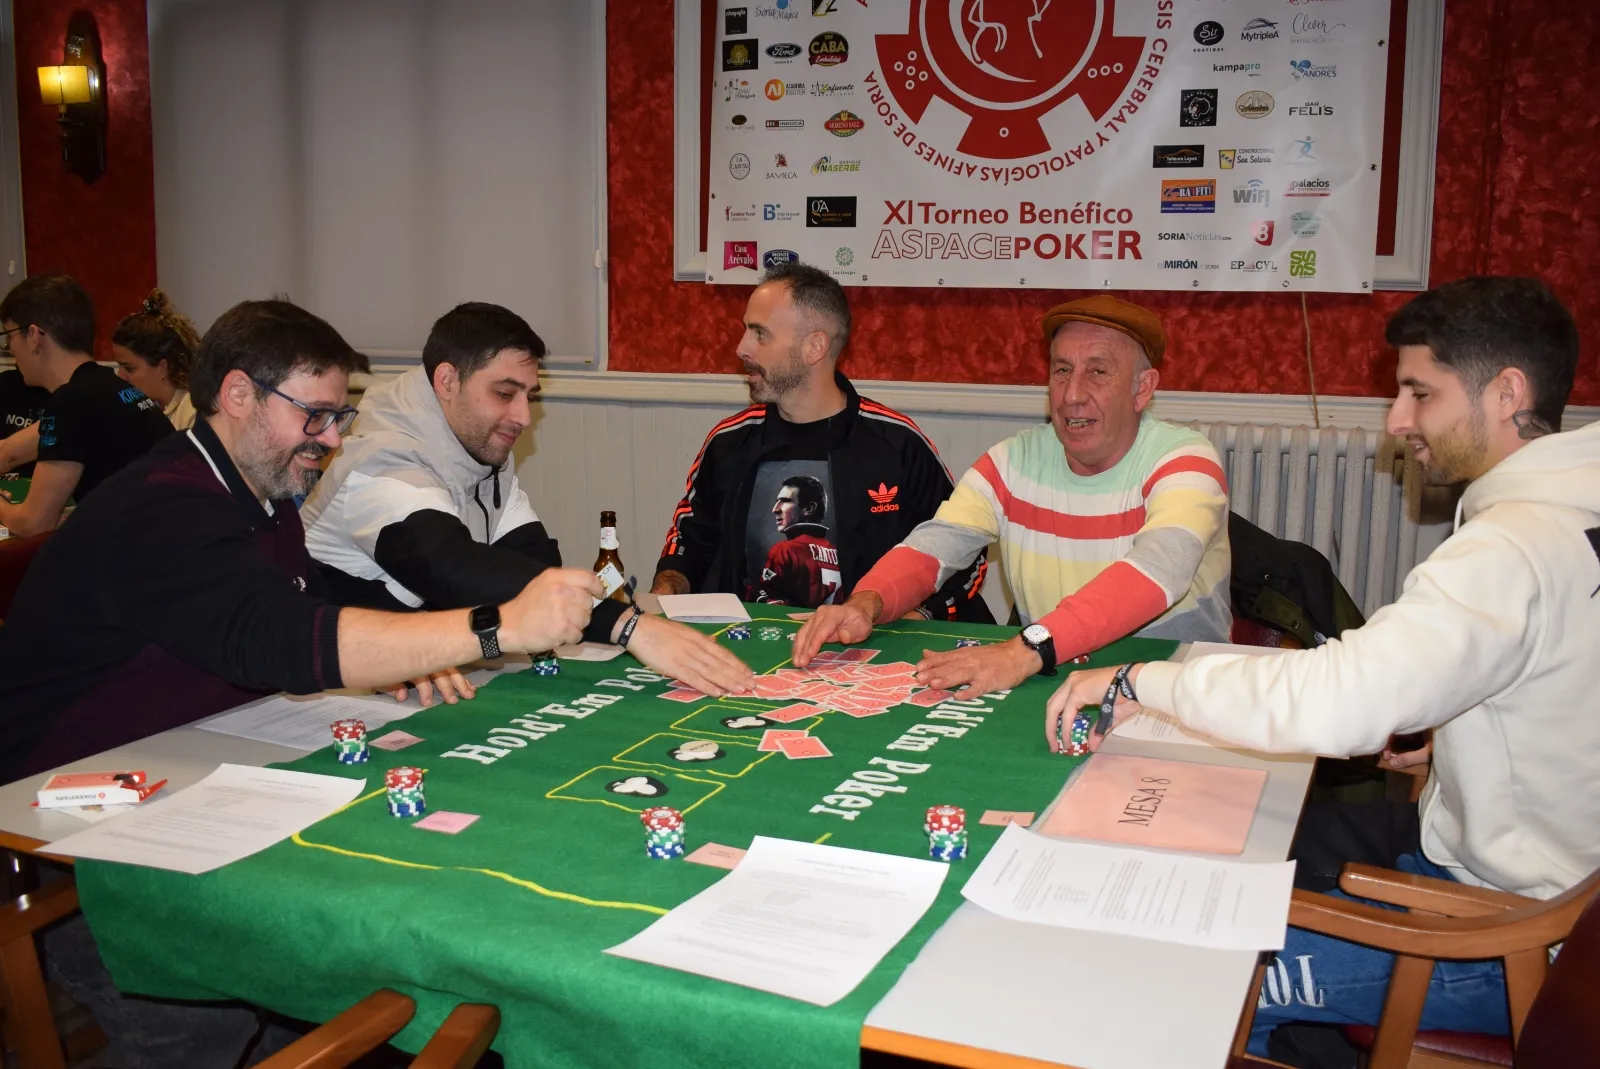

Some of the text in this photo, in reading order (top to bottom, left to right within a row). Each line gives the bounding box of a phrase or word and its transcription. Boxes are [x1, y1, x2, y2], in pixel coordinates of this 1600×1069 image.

[771, 45, 796, 56] Ford
[810, 40, 847, 54] CABA
[1213, 61, 1261, 73] kampapro
[1104, 38, 1168, 133] CEREBRAL
[863, 70, 898, 127] SORIA
[893, 123, 917, 147] DE
[1096, 132, 1110, 147] Y
[820, 163, 861, 172] NASERBE
[914, 141, 978, 178] AFINES
[980, 140, 1095, 185] PATOLOGÍAS
[1291, 178, 1330, 190] palacios
[883, 200, 1133, 225] XI Torneo Benéfico
[734, 244, 747, 252] Casa
[727, 254, 754, 265] Arévalo
[870, 503, 900, 513] adidas
[820, 567, 843, 605] 7
[808, 756, 932, 821] Poker
[1117, 776, 1171, 827] MESA 8
